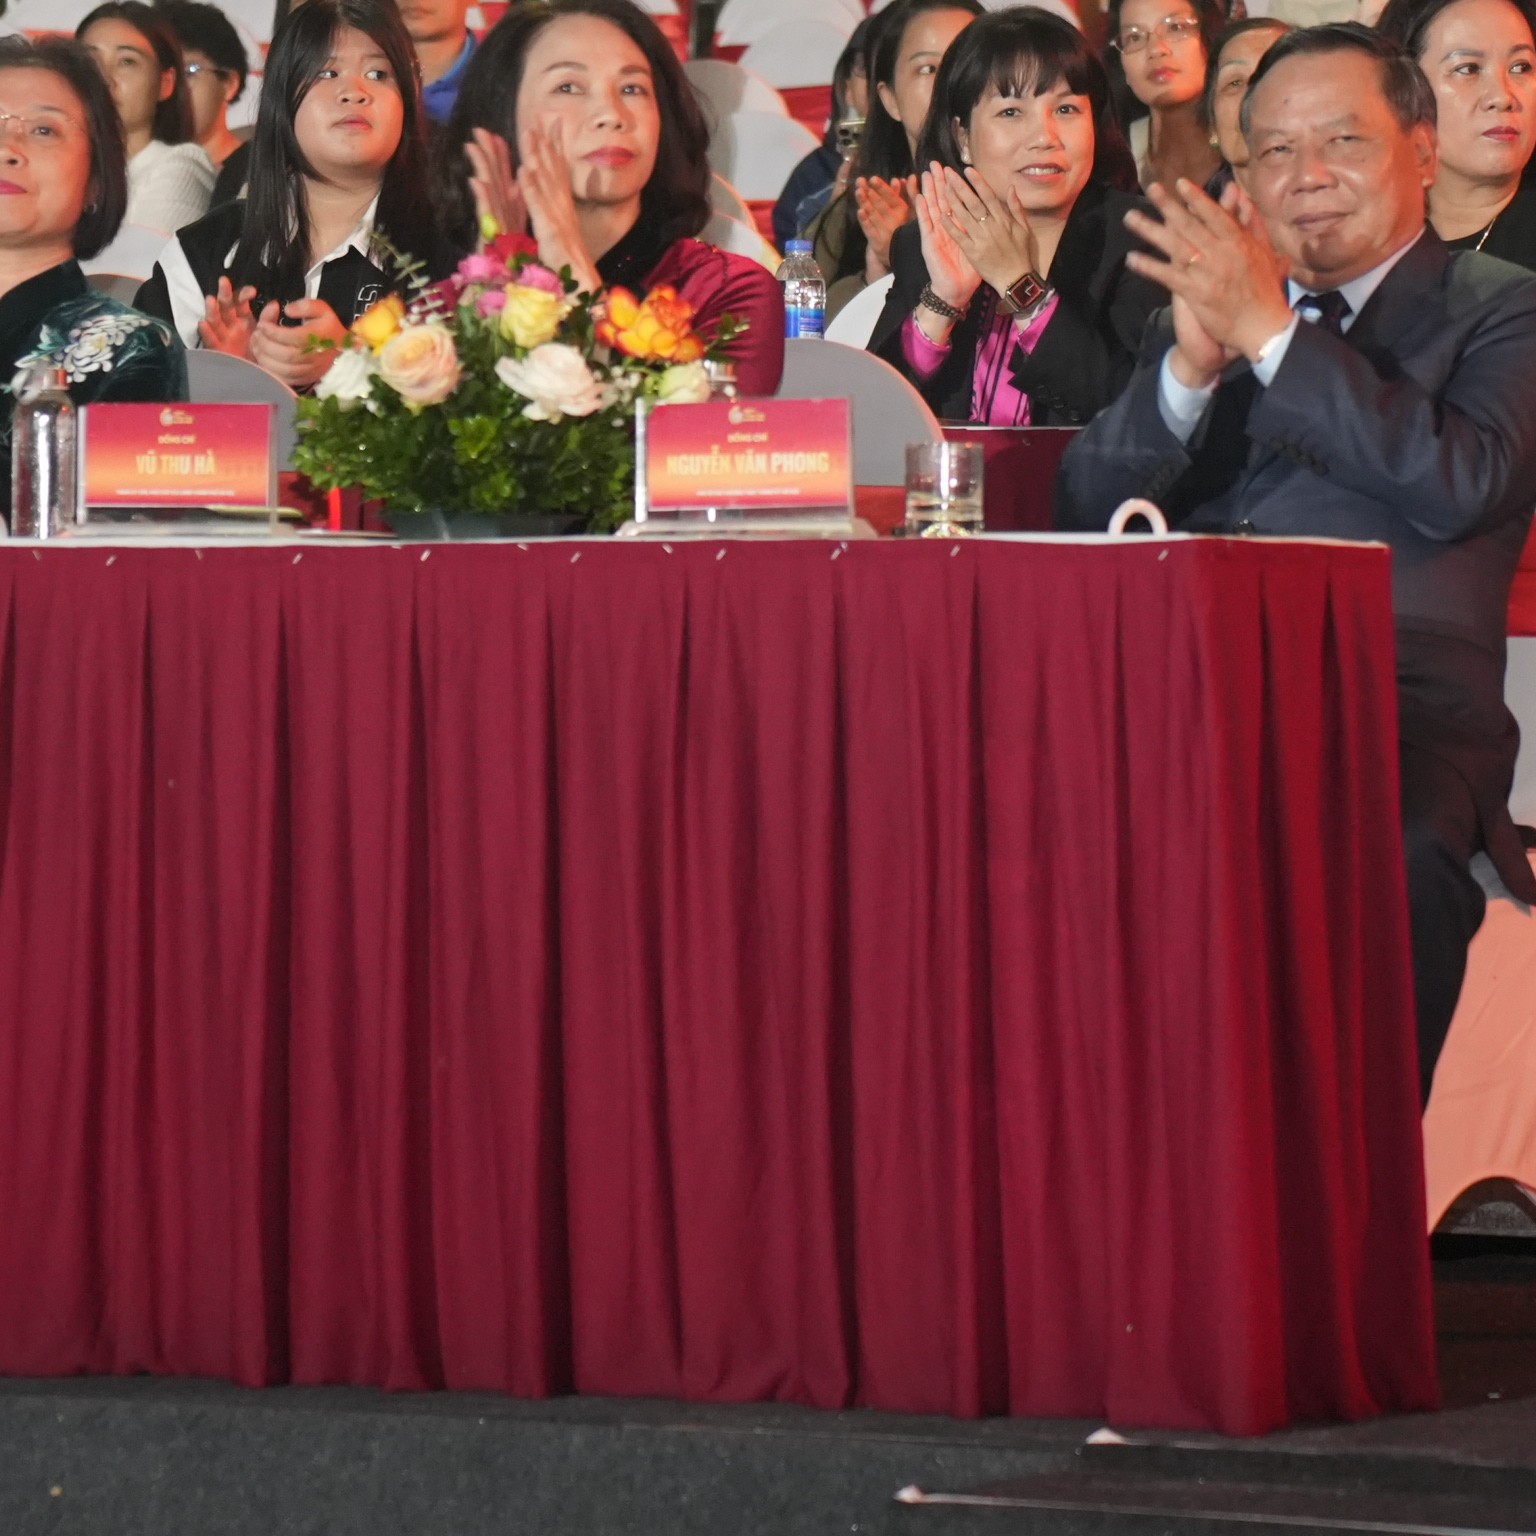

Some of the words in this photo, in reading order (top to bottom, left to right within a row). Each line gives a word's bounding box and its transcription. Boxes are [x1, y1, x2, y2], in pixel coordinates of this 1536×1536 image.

[136, 449, 158, 476] VŨ
[159, 453, 192, 476] THU
[194, 448, 217, 476] HÀ
[733, 448, 768, 476] VĂN
[770, 450, 831, 475] PHONG
